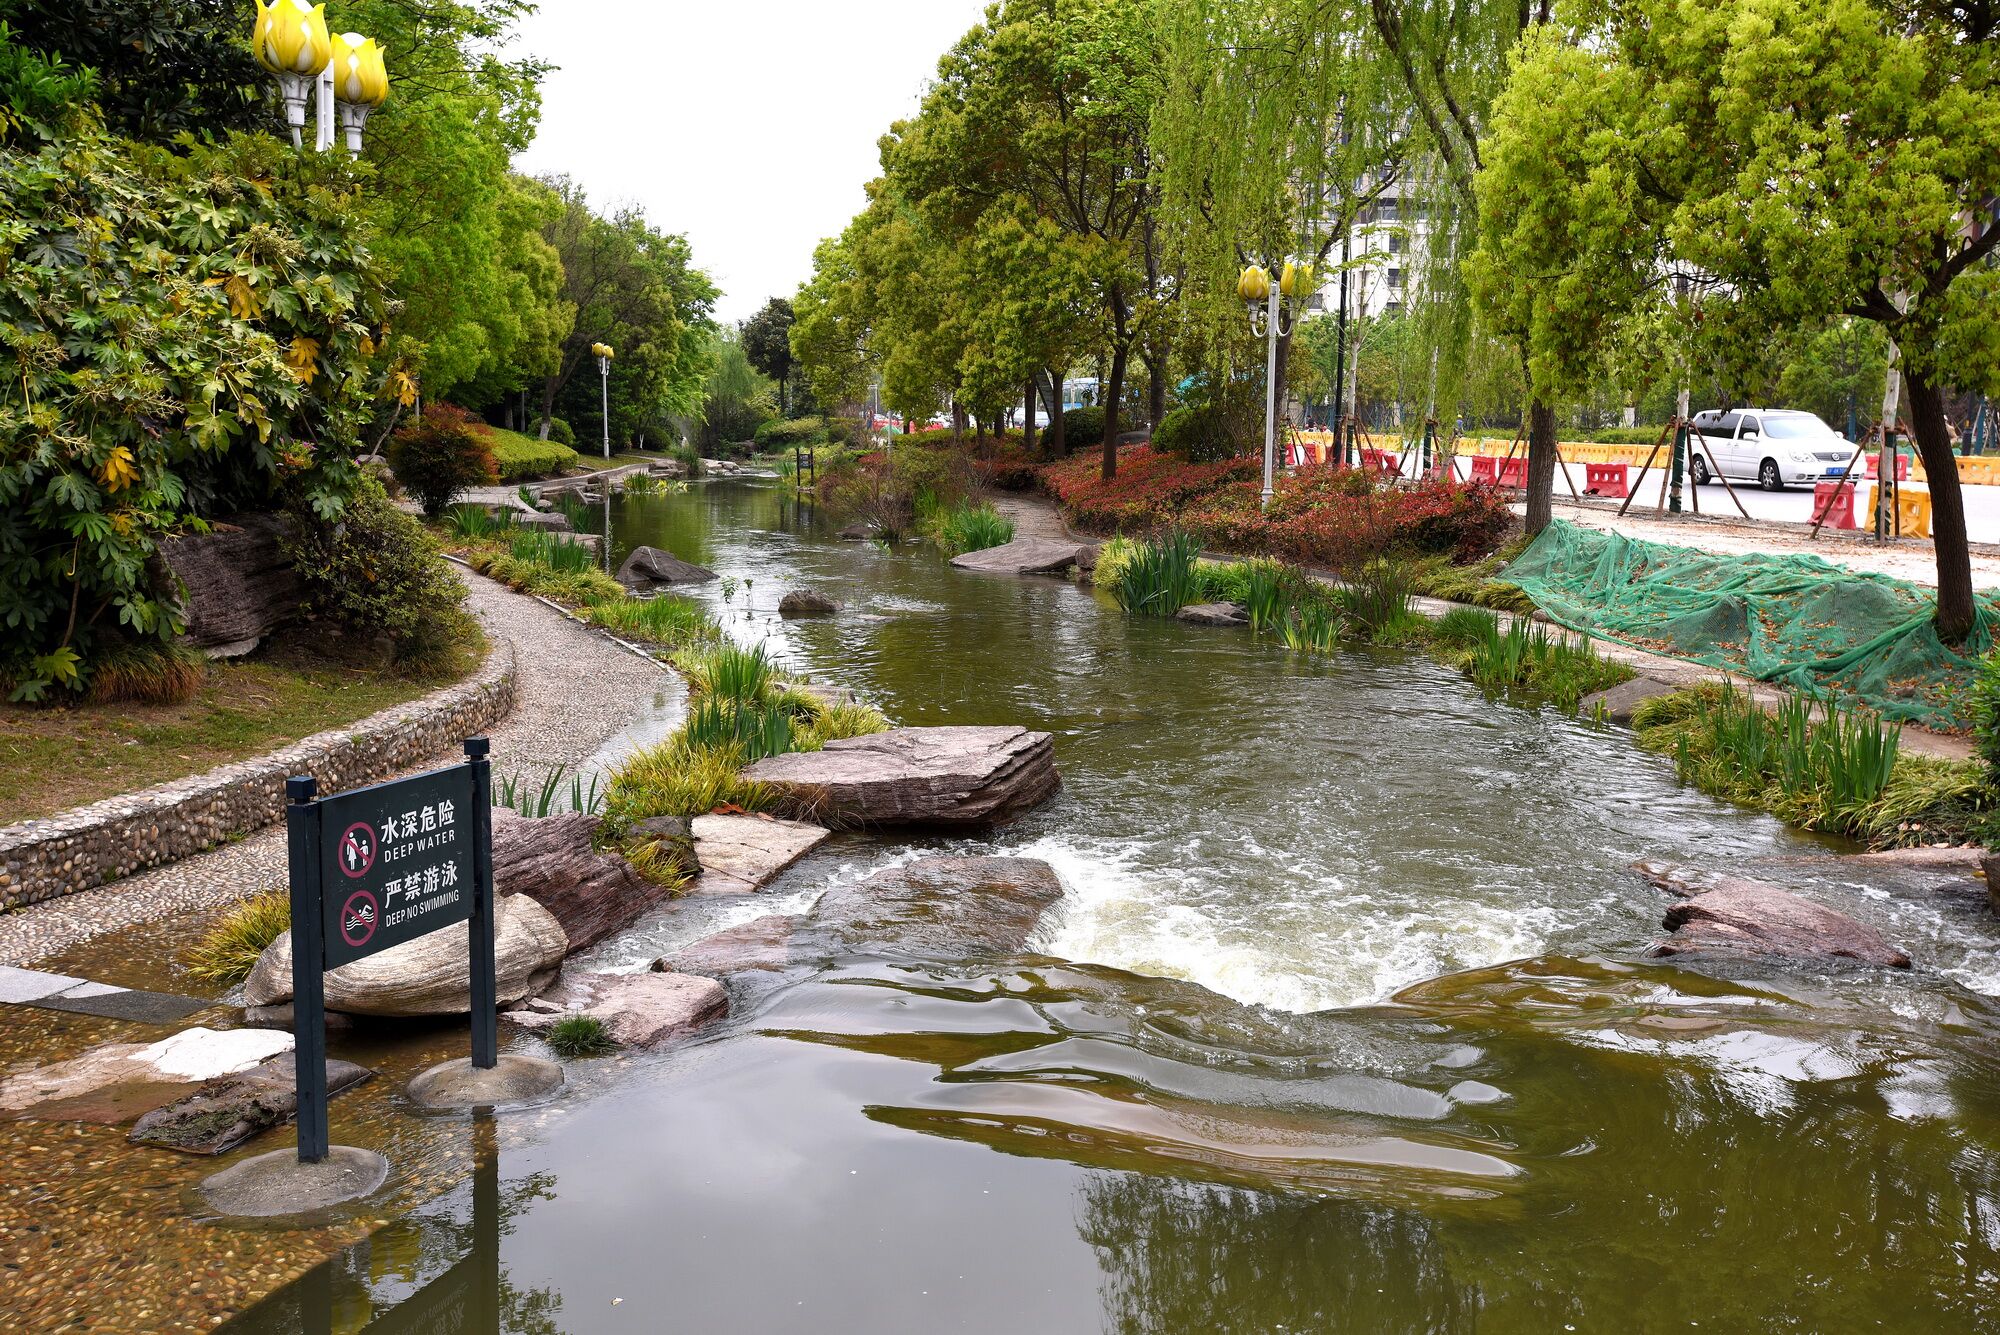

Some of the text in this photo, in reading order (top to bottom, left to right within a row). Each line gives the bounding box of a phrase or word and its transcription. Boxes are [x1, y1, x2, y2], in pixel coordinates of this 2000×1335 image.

[381, 799, 455, 845] 水深危险
[384, 829, 455, 863] DEEP WATER
[384, 859, 458, 909] 严禁游泳
[385, 889, 460, 928] DEEP NO SWIMMING
